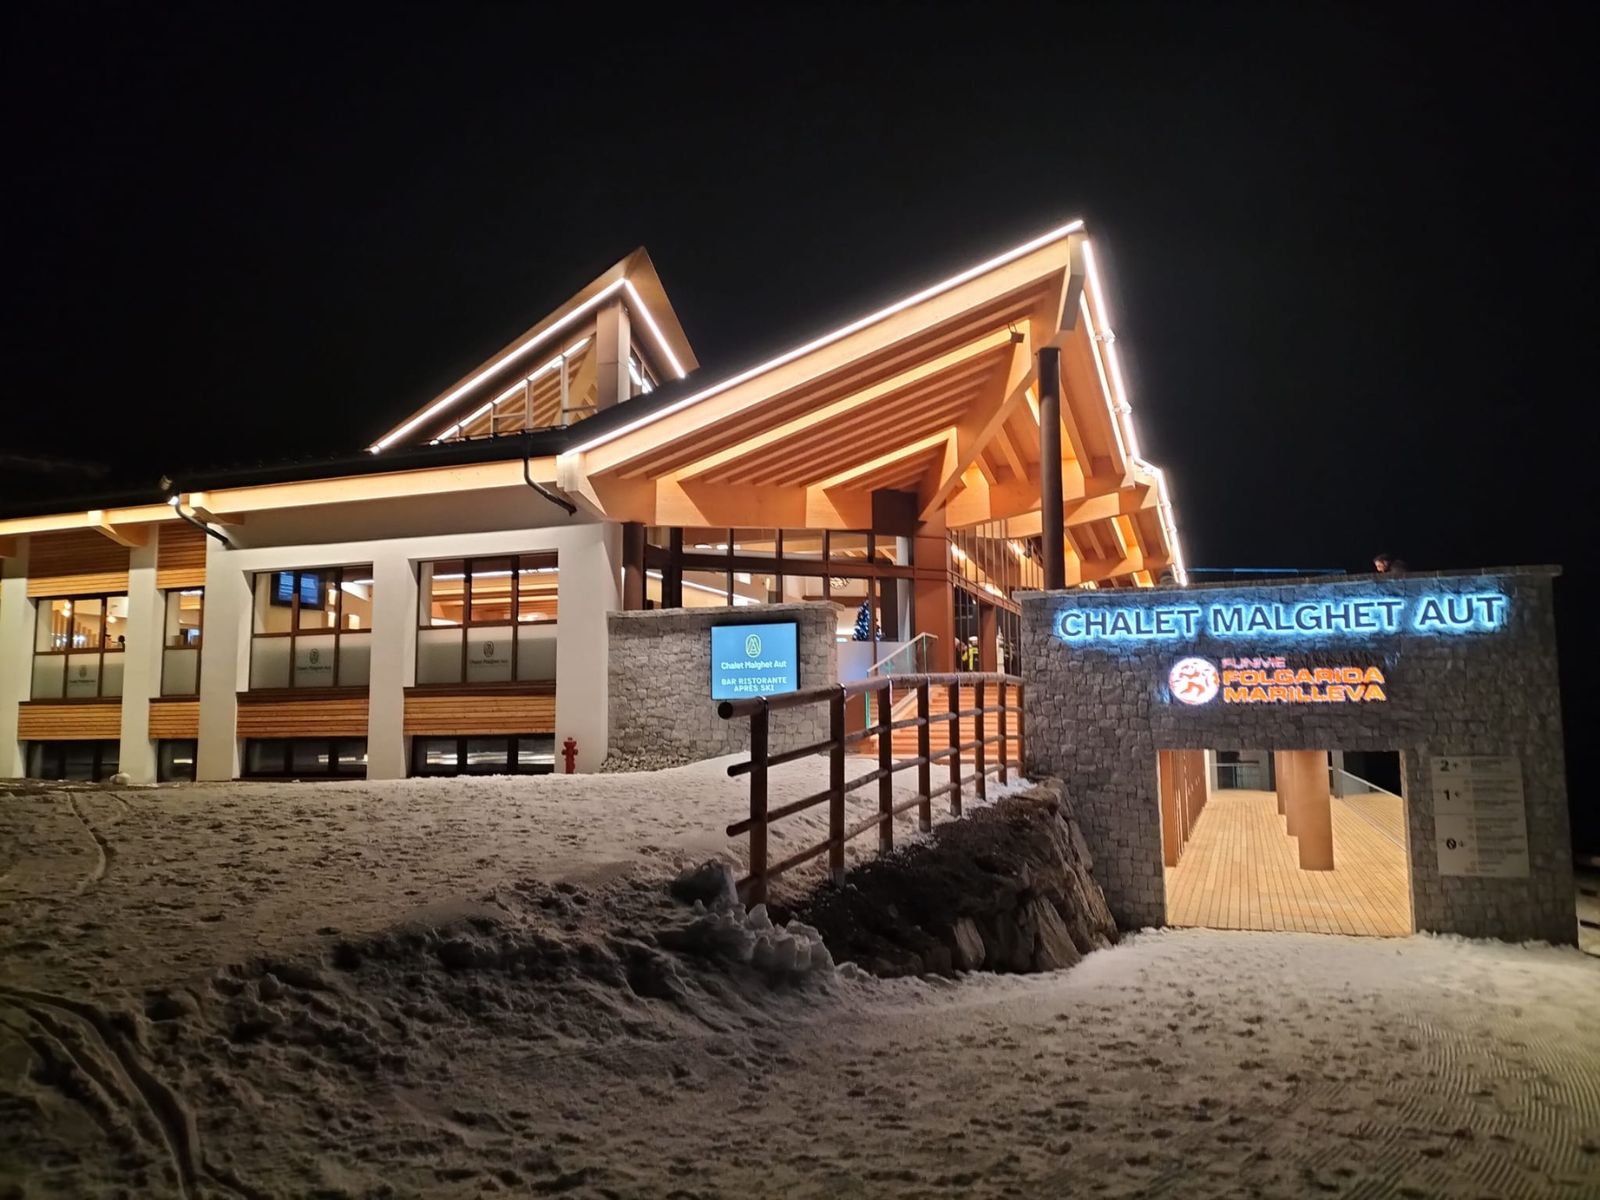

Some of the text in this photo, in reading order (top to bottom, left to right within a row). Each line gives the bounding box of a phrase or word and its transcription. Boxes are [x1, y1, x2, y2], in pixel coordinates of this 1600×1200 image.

[1060, 596, 1503, 637] CHALET MALGHET AUT
[721, 660, 787, 671] Chalet Malghet Aut
[721, 676, 788, 686] BAR RISTORANTE
[1222, 666, 1386, 686] FOLGARIDA
[760, 683, 775, 692] SKI
[1222, 684, 1387, 703] MARILLEVA
[1440, 759, 1450, 772] 2
[1443, 789, 1451, 801] 1
